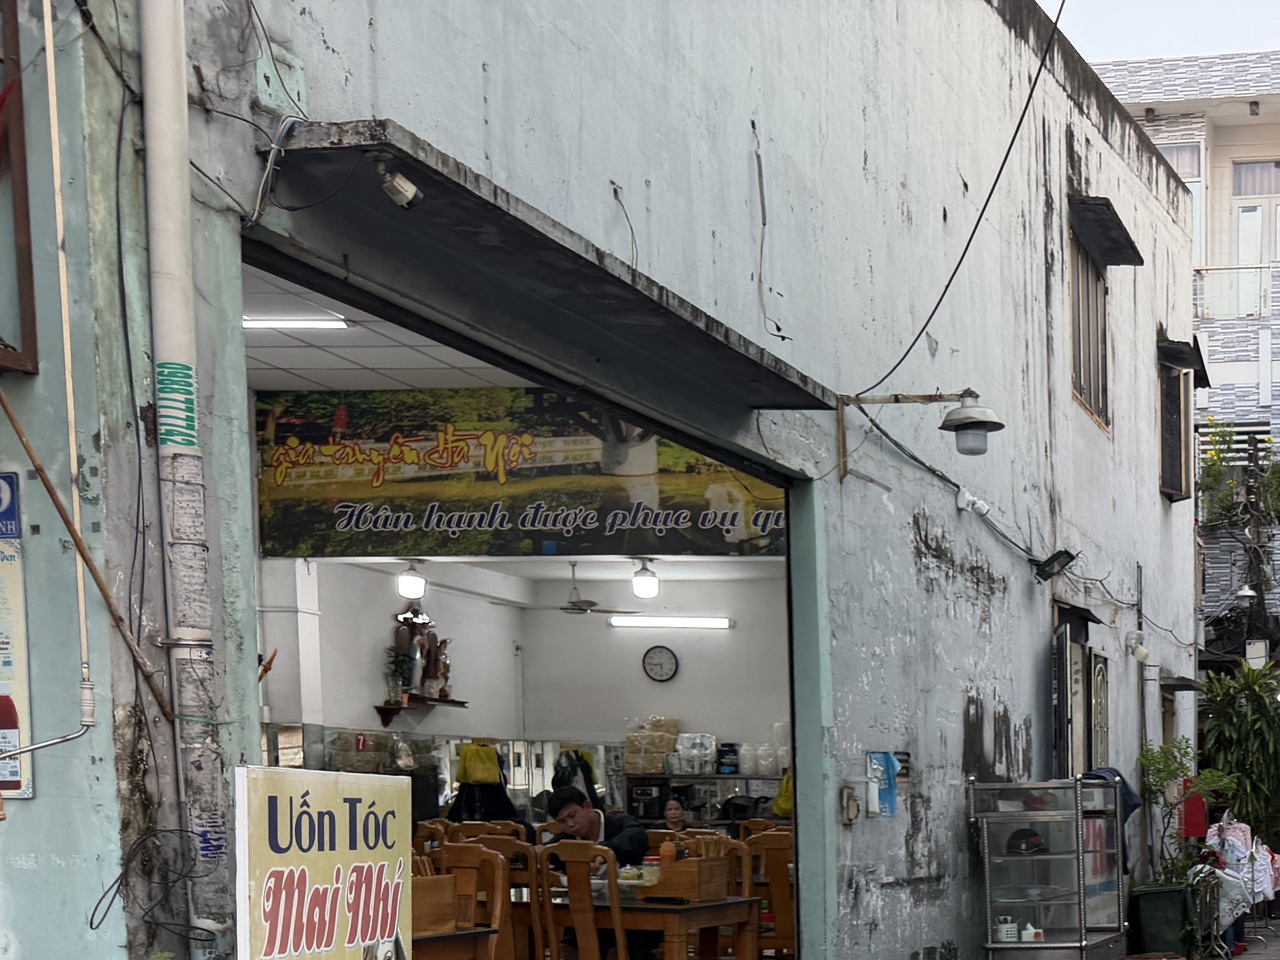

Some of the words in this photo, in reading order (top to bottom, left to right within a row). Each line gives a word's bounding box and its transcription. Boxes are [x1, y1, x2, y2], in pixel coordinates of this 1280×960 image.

[479, 431, 538, 485] Nội
[334, 501, 416, 532] Hân
[421, 501, 512, 538] hạnh
[518, 500, 600, 536] được
[605, 500, 692, 536] phục
[700, 508, 744, 536] vụ
[267, 789, 336, 854] Uốn
[343, 797, 396, 851] Tóc
[262, 865, 341, 958] Mai
[346, 858, 403, 946] Nhí
